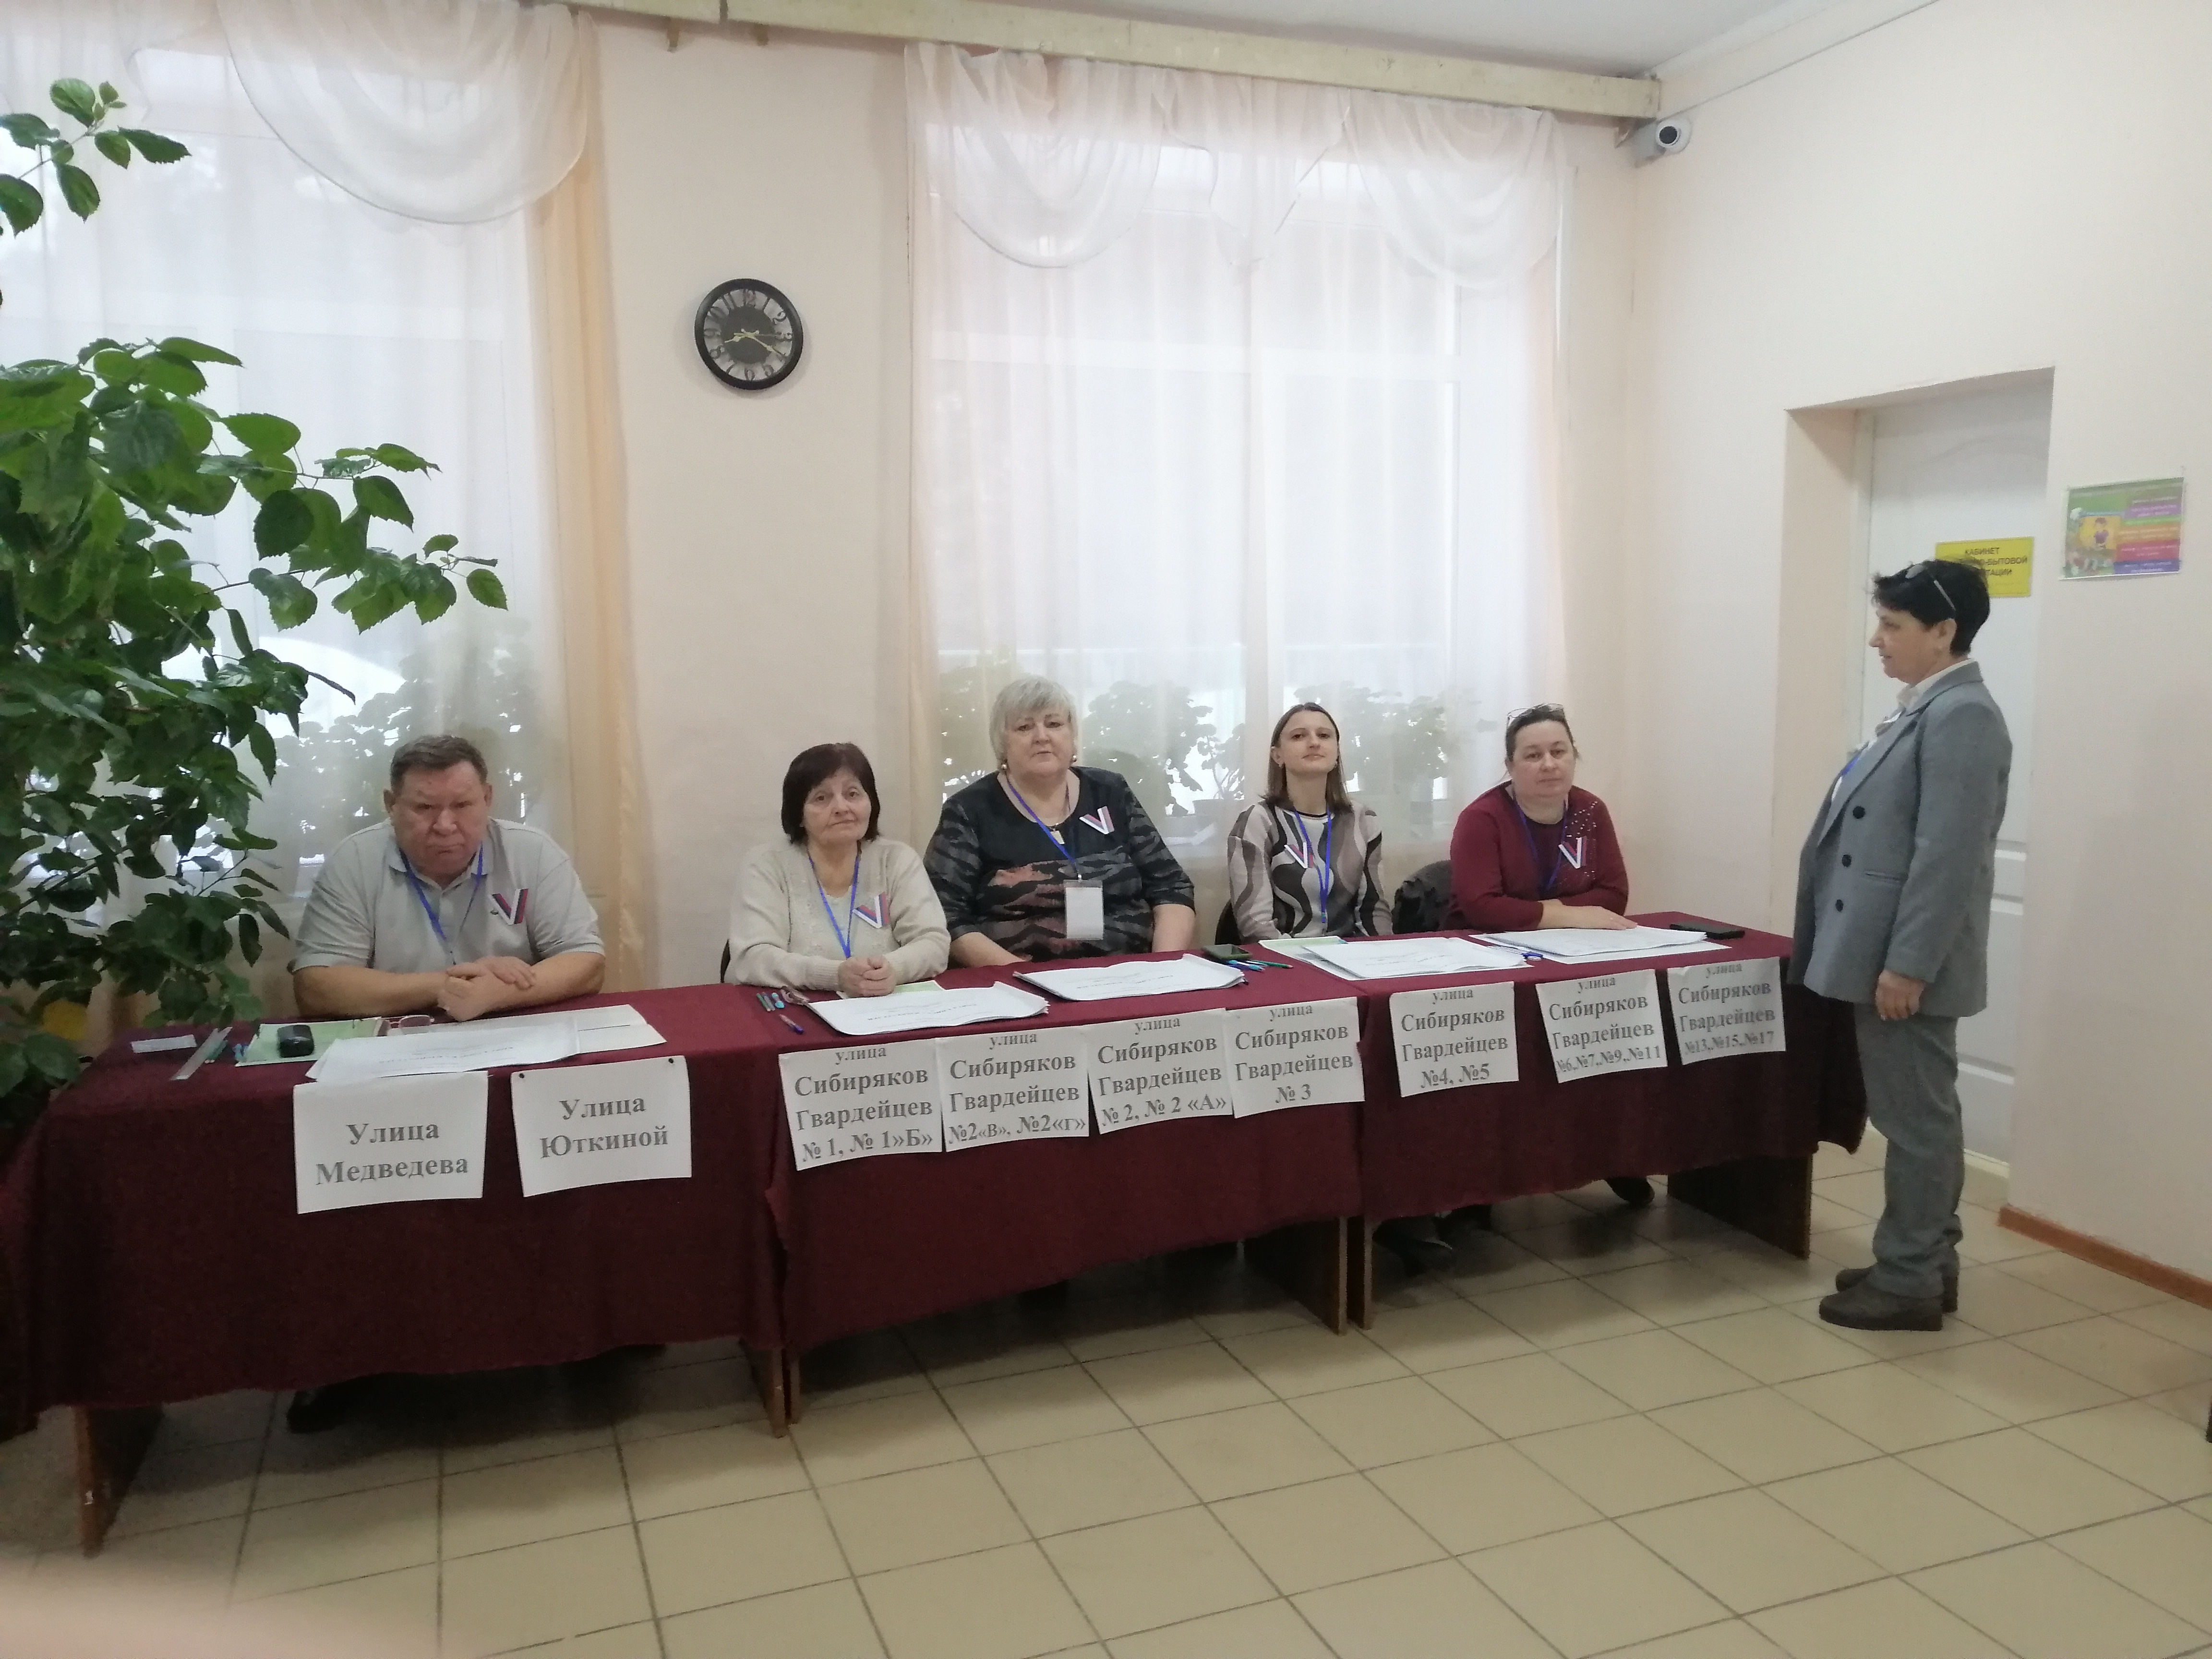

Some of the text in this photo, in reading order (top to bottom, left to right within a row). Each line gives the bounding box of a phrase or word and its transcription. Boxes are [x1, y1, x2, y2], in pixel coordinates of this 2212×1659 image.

[1706, 963, 1743, 978] улица
[1577, 977, 1616, 994] улица
[1678, 983, 1771, 1004] Сибиряков
[1432, 989, 1473, 1005] улица
[1269, 1005, 1313, 1022] улица
[1549, 997, 1648, 1020] Сибиряков
[1134, 1018, 1180, 1035] улица
[1401, 1010, 1505, 1032] Сибиряков
[1680, 1009, 1776, 1032] Гвардейцев
[989, 1034, 1037, 1050] улица
[1235, 1026, 1349, 1050] Сибиряков
[1551, 1023, 1654, 1049] Гвардейцев
[835, 1047, 887, 1066] улица
[1098, 1038, 1217, 1064] Сибиряков
[1402, 1036, 1508, 1062] Гвардейцев
[950, 1056, 1076, 1079] Сибиряков
[1235, 1054, 1354, 1081] Гвардейцев
[1458, 1063, 1490, 1083] №5
[795, 1070, 929, 1096] Сибиряков
[1098, 1067, 1222, 1096] Гвардейцев
[949, 1084, 1080, 1113] Гвардейцев
[1171, 1096, 1181, 1113] 2
[1275, 1083, 1311, 1104] № 3
[559, 1098, 646, 1120] Улица
[795, 1100, 933, 1131] Гвардейцев
[346, 1123, 440, 1145] Улица
[540, 1125, 668, 1159] Юткиной
[315, 1158, 469, 1185] Медведева
